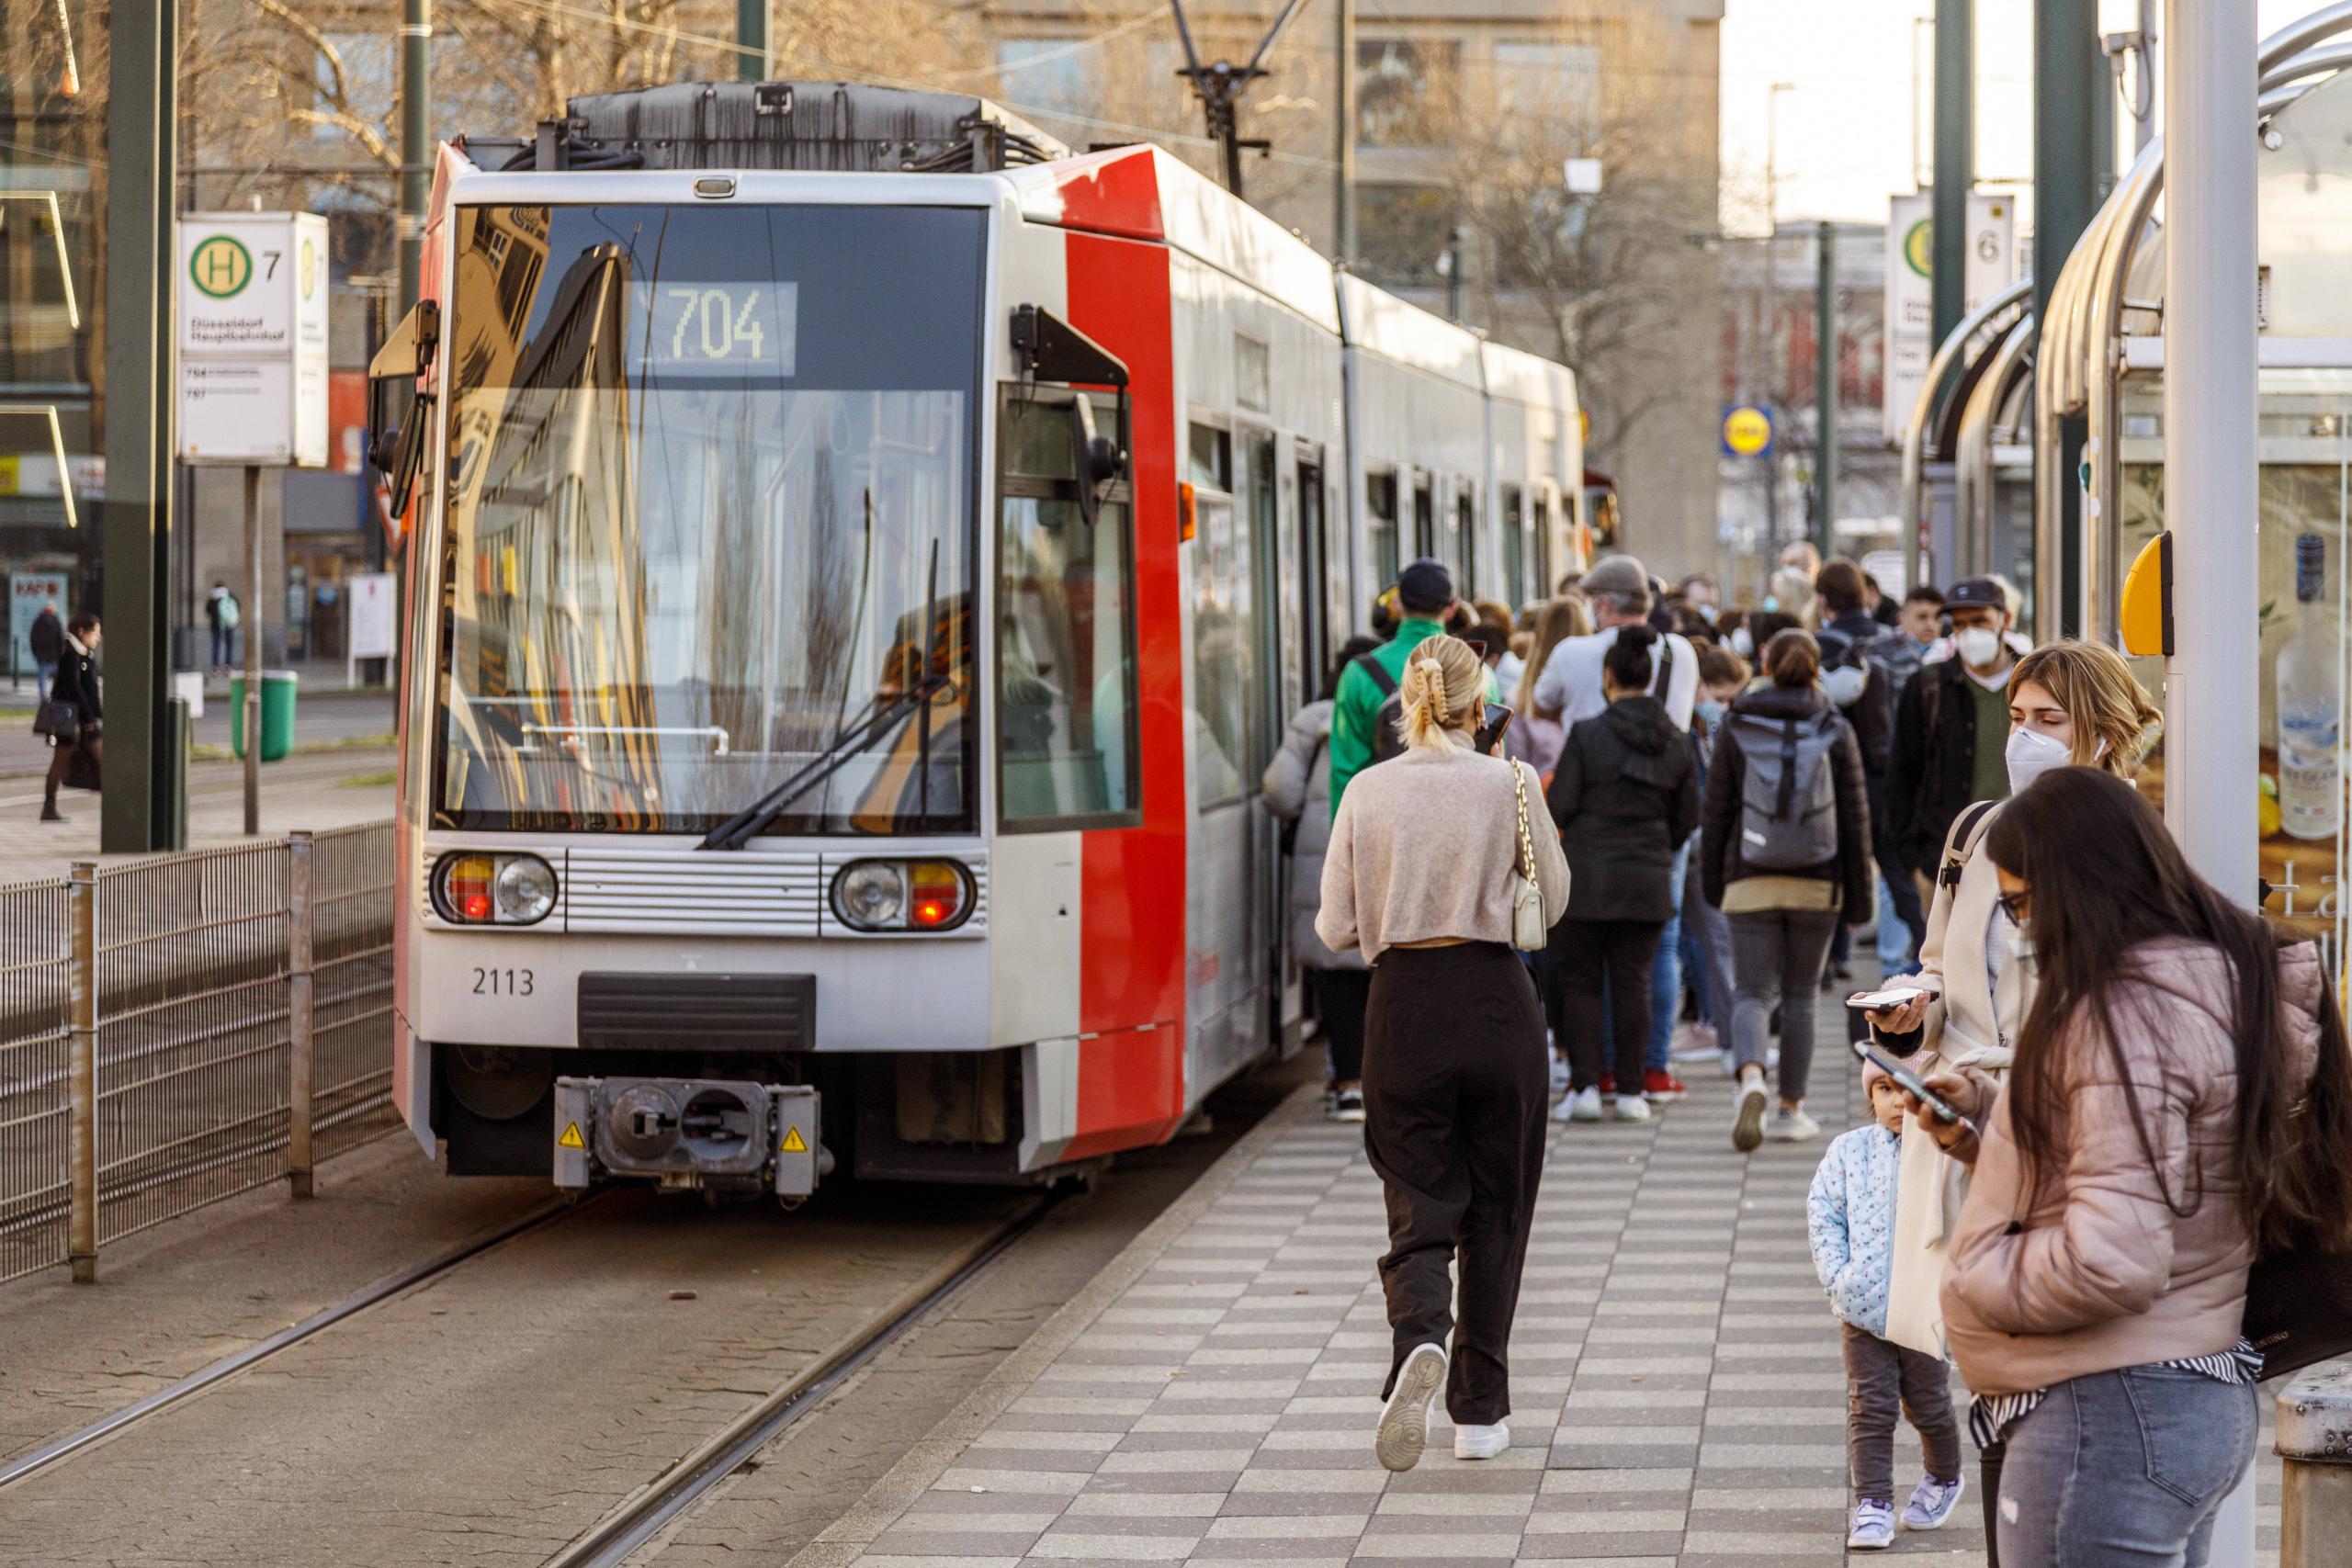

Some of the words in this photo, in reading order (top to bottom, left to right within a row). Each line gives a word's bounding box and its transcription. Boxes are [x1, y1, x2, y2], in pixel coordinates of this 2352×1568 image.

[1977, 231, 2000, 265] 6
[209, 249, 234, 284] H
[263, 251, 282, 281] 7
[191, 316, 264, 329] Düsseldorf
[191, 329, 285, 344] Hauptbahnhof
[668, 288, 764, 359] 704
[472, 966, 535, 997] 2113
